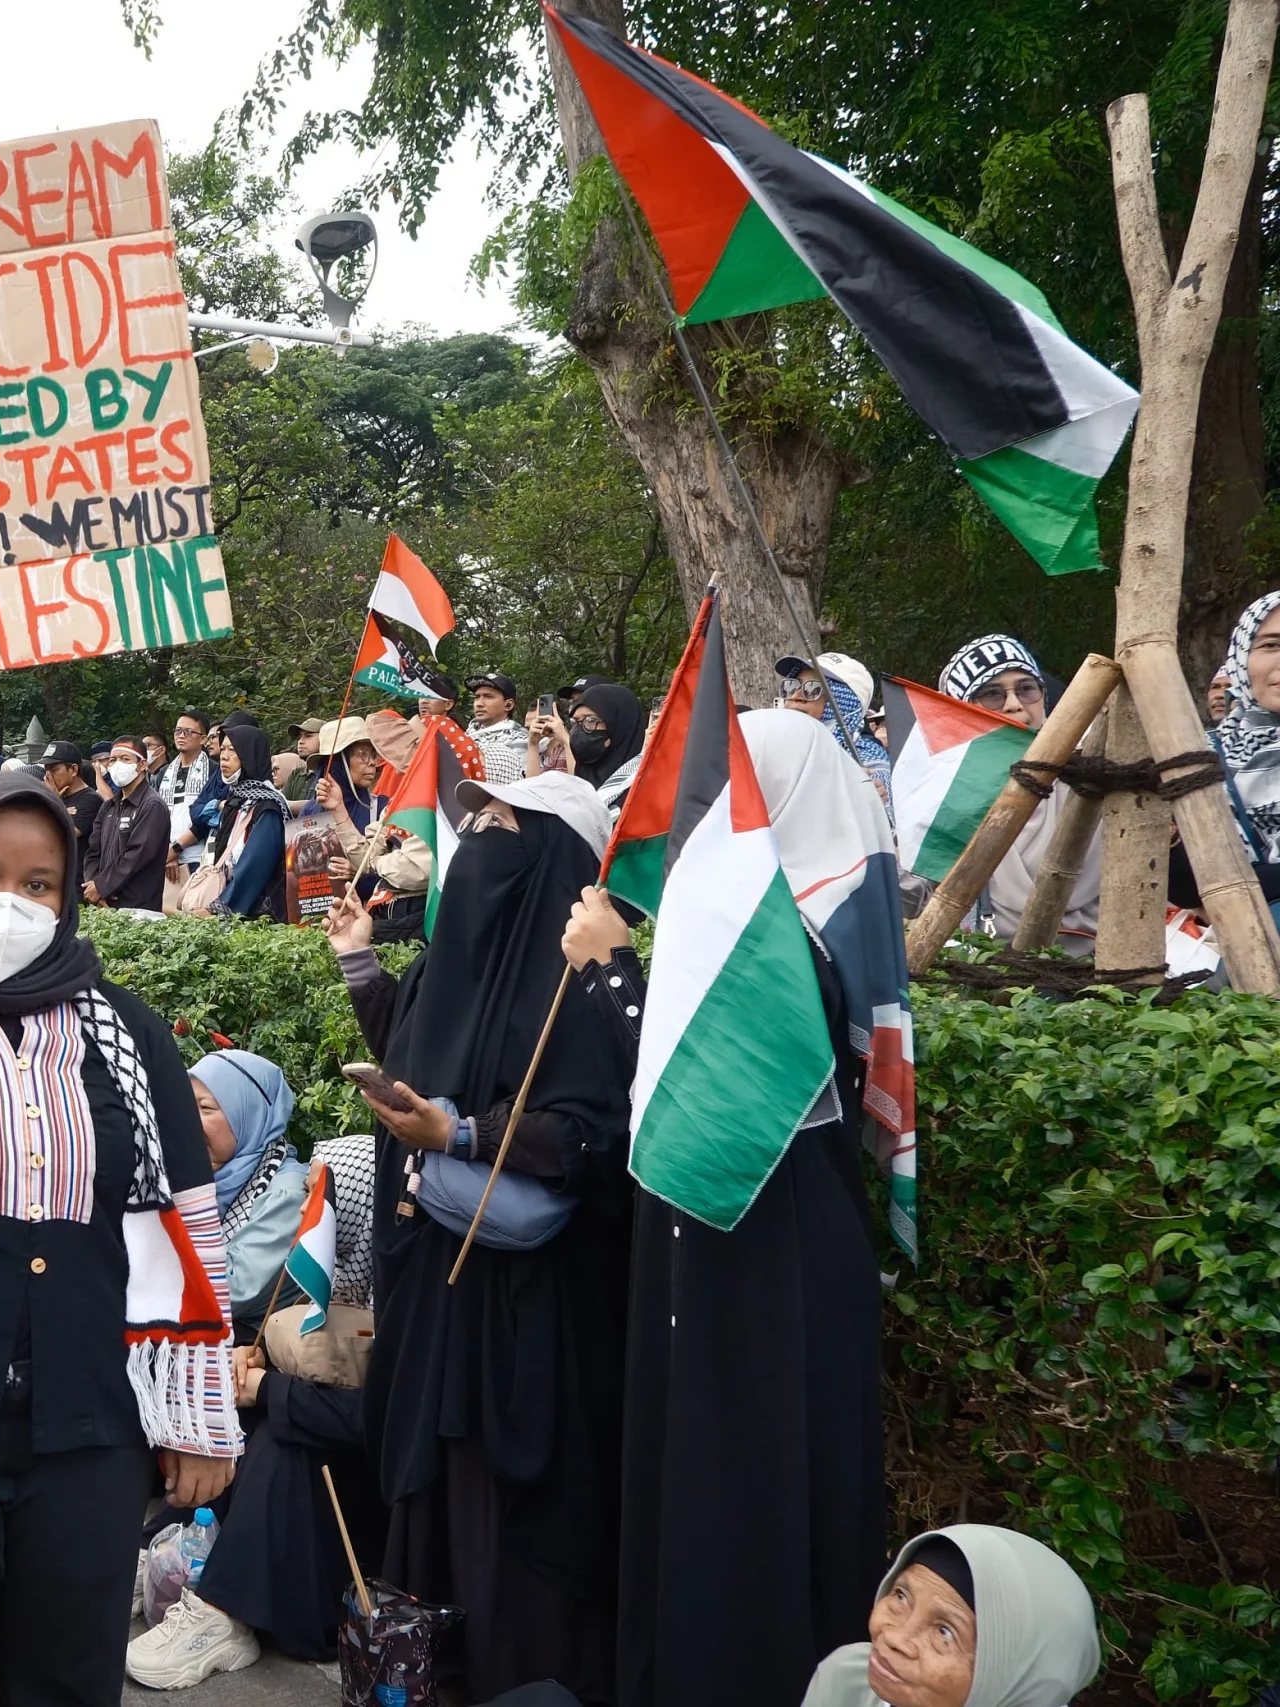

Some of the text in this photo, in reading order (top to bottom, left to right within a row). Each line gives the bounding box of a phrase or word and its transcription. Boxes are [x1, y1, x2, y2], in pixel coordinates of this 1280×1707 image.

[85, 362, 172, 428] BY
[20, 498, 108, 554] WE
[111, 485, 210, 543] MUST
[397, 640, 434, 685] FREE
[946, 650, 987, 700] AVE
